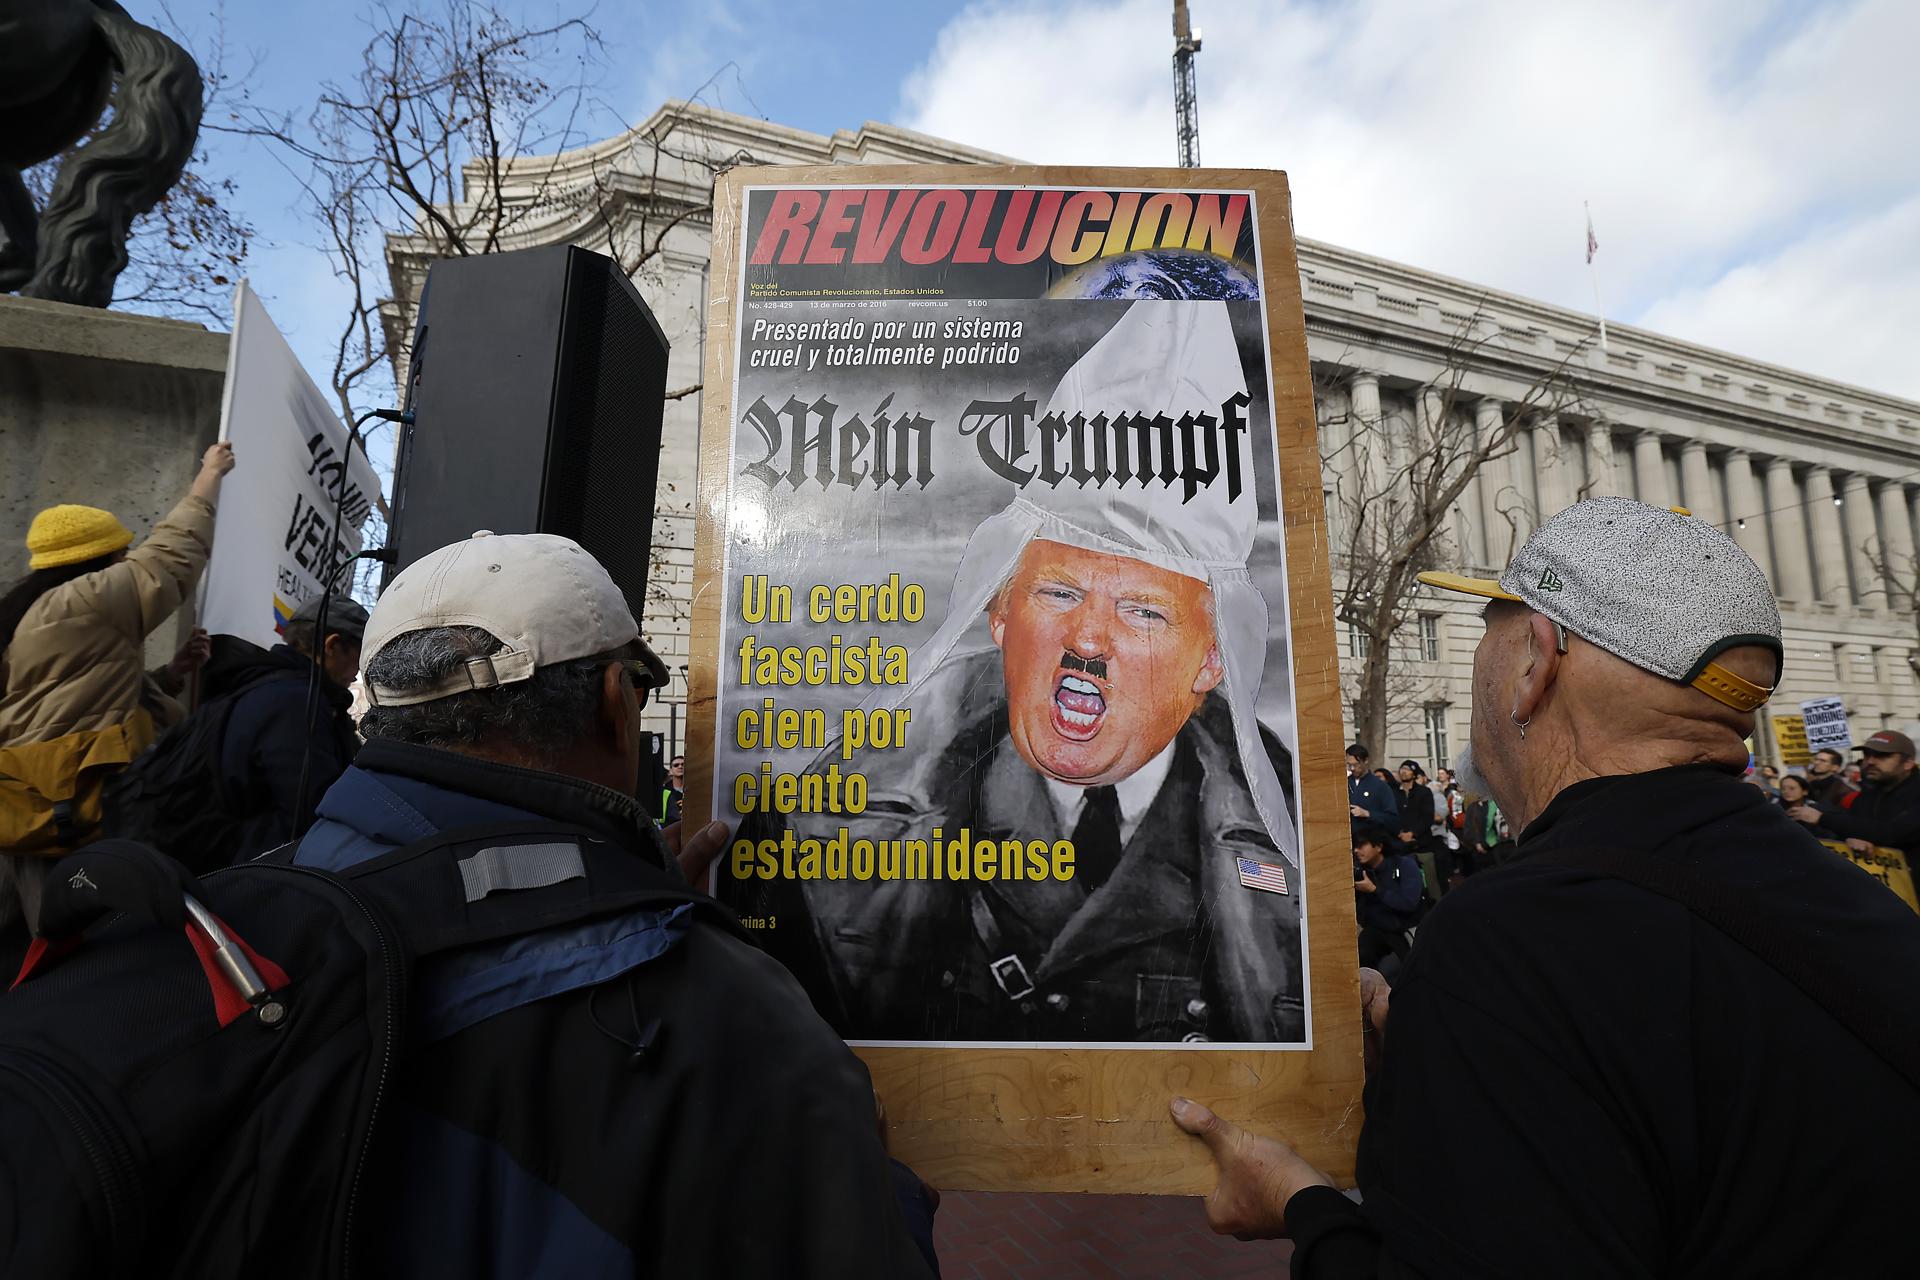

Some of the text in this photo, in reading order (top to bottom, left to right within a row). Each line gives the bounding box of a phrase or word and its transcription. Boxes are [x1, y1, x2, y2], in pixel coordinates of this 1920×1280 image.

[749, 189, 1250, 265] REVOLUCION
[750, 289, 778, 297] Partido
[751, 316, 1024, 343] Presentado por un sistema
[750, 341, 1020, 371] cruel y totalmente podrido
[739, 390, 1254, 505] Mein Trumpf
[741, 573, 926, 624] Un cerdo
[739, 635, 909, 686] fascista
[736, 698, 912, 760] cien por
[733, 762, 869, 815] ciento
[731, 827, 1076, 882] estadounidense
[768, 915, 777, 930] 3
